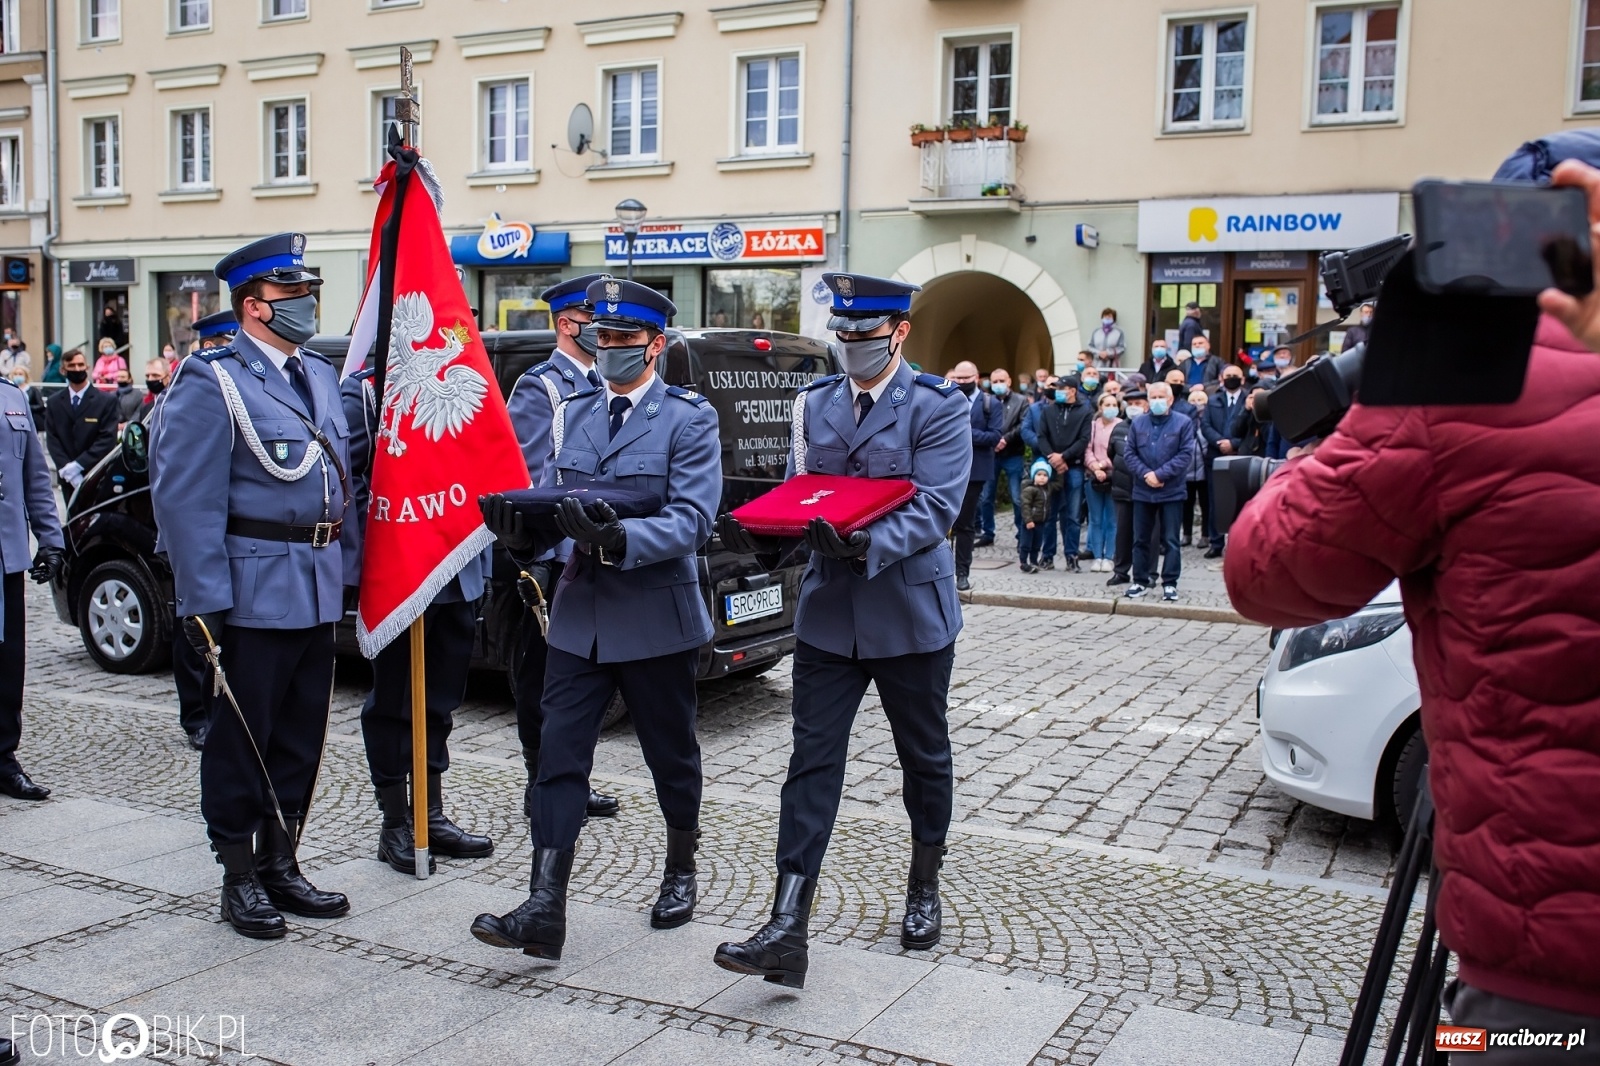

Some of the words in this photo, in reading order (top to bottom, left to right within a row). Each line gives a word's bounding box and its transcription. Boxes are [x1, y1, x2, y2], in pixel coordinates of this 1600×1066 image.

[1226, 213, 1342, 233] RAINBOW
[489, 229, 521, 249] LOTTO
[608, 236, 707, 255] MATERACE
[751, 231, 818, 251] ŁÓŻKA
[1169, 256, 1207, 265] WCZASY
[85, 261, 119, 281] Juliette
[1164, 268, 1211, 277] WYCIECZKI
[708, 371, 760, 389] USŁUGI
[738, 435, 780, 451] RACIBÓRZ,
[745, 454, 756, 467] tel.
[757, 454, 778, 468] 32/415
[733, 594, 754, 615] SRC
[756, 588, 780, 610] 9RC3
